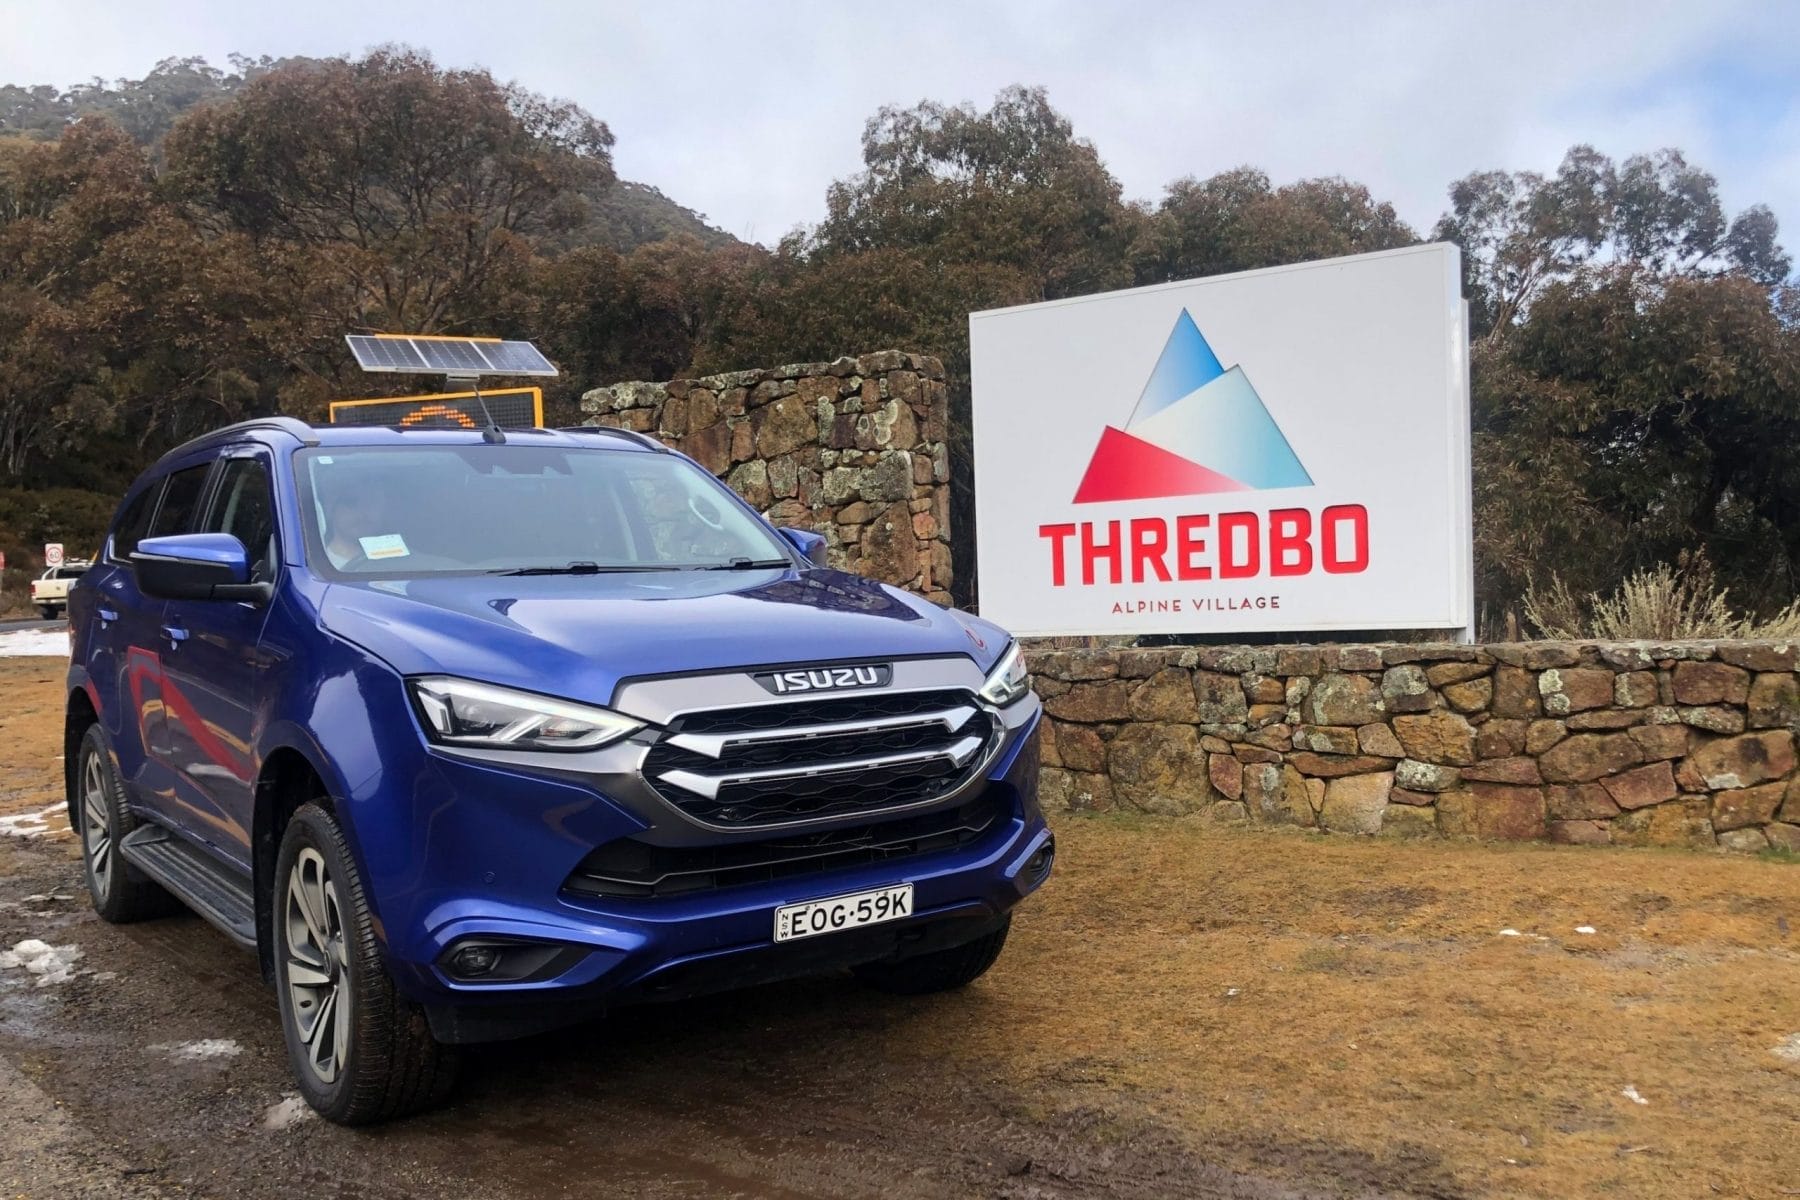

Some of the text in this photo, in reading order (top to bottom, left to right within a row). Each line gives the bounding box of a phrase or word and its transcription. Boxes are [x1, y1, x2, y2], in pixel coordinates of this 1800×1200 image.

[1038, 503, 1370, 587] THREDBO
[1112, 596, 1281, 614] ALPINE VILLAGE
[773, 667, 878, 692] ISUZU
